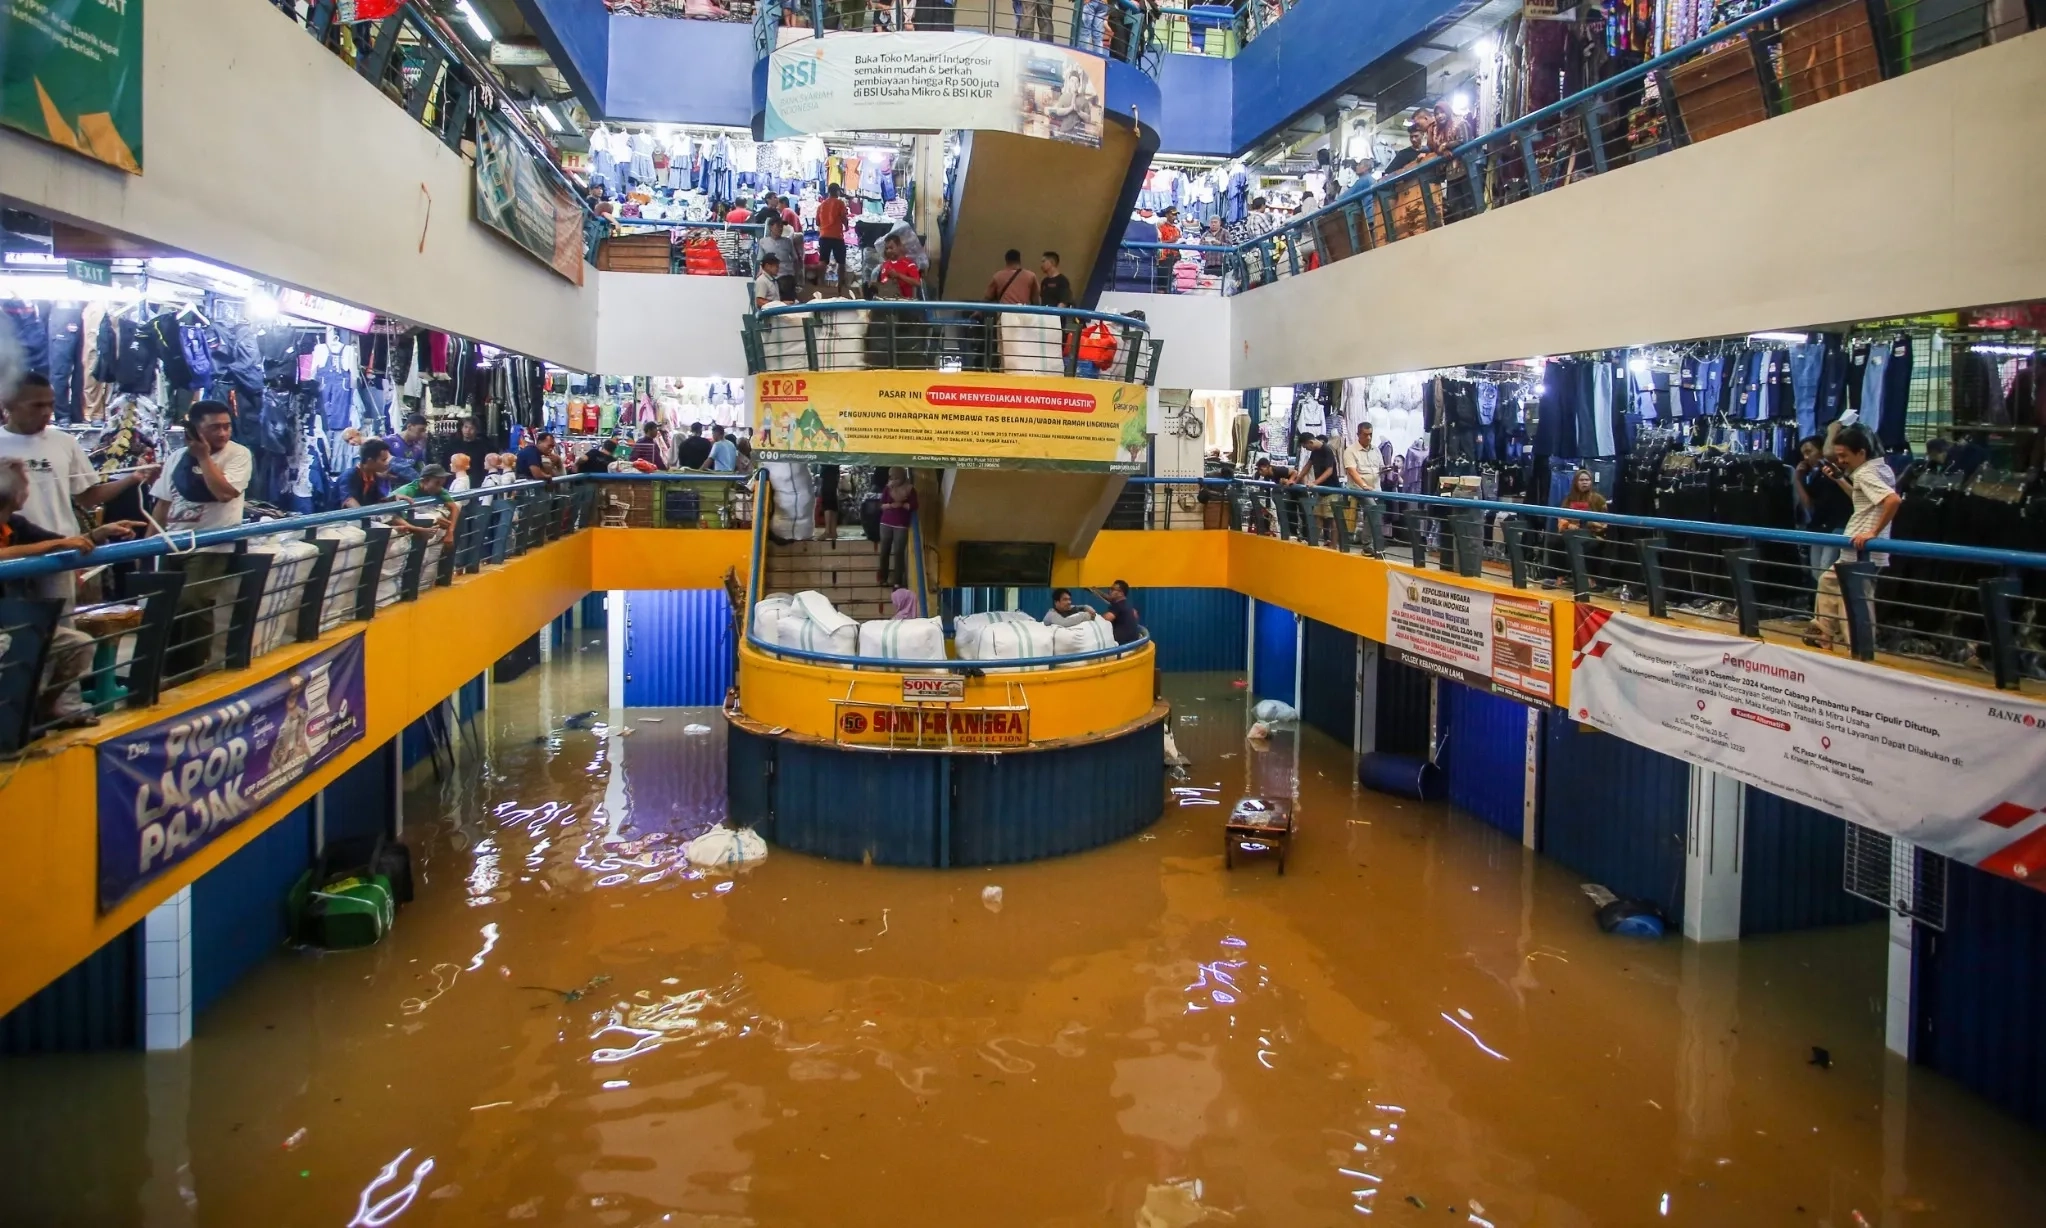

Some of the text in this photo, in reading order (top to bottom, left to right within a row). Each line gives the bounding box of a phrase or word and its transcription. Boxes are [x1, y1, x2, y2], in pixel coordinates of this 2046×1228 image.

[855, 54, 993, 66] Buka Toko Mandiri Indogrosir
[781, 59, 817, 91] BSI
[854, 65, 972, 75] semakin mudah & berkah
[854, 76, 1000, 89] pembiayaan hingga Rp 500 juta
[853, 87, 993, 98] di BSI Usaha Mikro & BSI KUR
[75, 264, 104, 281] EXIT
[762, 380, 807, 395] STOP
[879, 390, 1095, 408] PASAR INI "TIDAK MENYEDIAKAN KANTONG PLASTIK"
[839, 411, 1120, 429] PENGUNJUNG DIHARAPKAN MEMBAWA TAS BELANJA/WADAH RAMAH LINGKUNGAN
[1421, 596, 1470, 613] REPUBLIK INDONESIA
[1422, 587, 1471, 604] KEPOLISIAN NEGARA
[1401, 652, 1464, 681] POLSEK KEBAYORAN LAMA
[1722, 652, 1805, 684] Pengumuman
[903, 681, 942, 690] SONY
[1672, 670, 1690, 681] Terima
[1691, 676, 1706, 685] Kasih
[1707, 679, 1722, 689] Atas
[1761, 692, 1786, 705] Seluruh
[1788, 697, 1818, 716] Nasabah
[1818, 708, 1824, 716] &
[1825, 710, 1844, 722] Mitra
[1846, 715, 1870, 729] Usaha
[1711, 670, 1741, 684] Desember
[1742, 678, 1759, 688] 2024
[1760, 681, 1783, 694] Kantor
[1784, 688, 1810, 703] Cabang
[1811, 695, 1849, 712] Pembantu
[1851, 706, 1873, 718] Pasar
[1875, 712, 1903, 727] Cipulir
[1904, 719, 1941, 738] Ditutup,
[873, 711, 1023, 735] SONY-RANGGA
[1987, 707, 2022, 724] BANK
[165, 699, 251, 770] PILIH
[1694, 685, 1717, 697] Kepada
[1745, 698, 1761, 709] Maka
[1762, 702, 1791, 718] Kegiatan
[1793, 710, 1824, 728] Transaksi
[1825, 721, 1846, 733] Serta
[1847, 726, 1880, 743] Layanan
[1881, 735, 1906, 751] Dapat
[1907, 743, 1951, 763] Dilakukan
[1951, 756, 1964, 768] di:
[959, 735, 1021, 743] COLLECTION
[1801, 748, 1817, 758] Pasar
[1818, 752, 1848, 768] Kebayoran
[1848, 763, 1865, 774] Lama
[136, 737, 248, 830] LAPOR
[1831, 767, 1850, 780] Jakarta
[1851, 773, 1874, 787] Selatan
[138, 773, 250, 875] PAJAK
